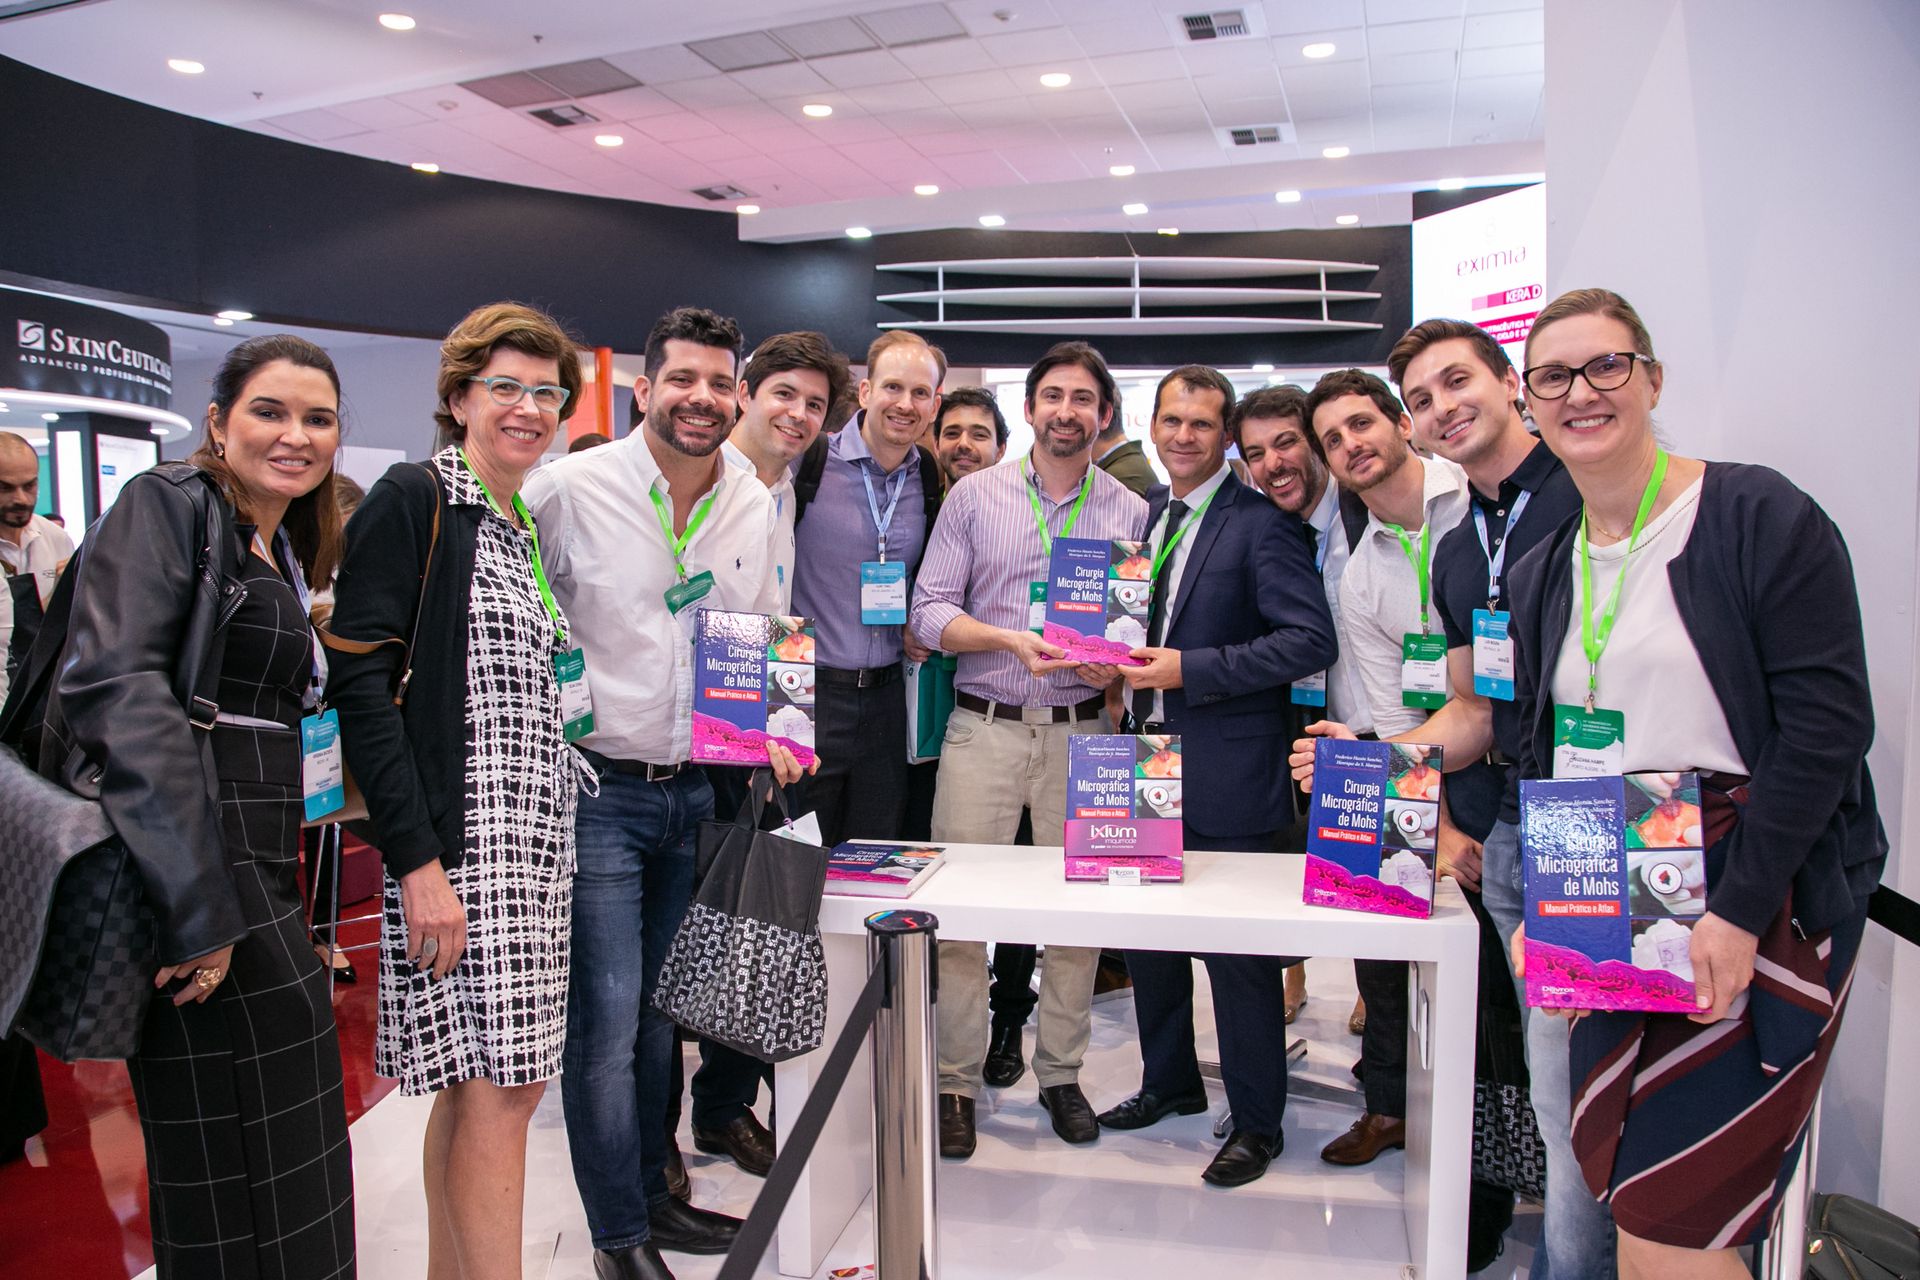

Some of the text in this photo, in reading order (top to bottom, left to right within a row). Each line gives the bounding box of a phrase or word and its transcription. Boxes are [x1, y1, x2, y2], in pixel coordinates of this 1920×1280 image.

[1457, 246, 1526, 276] eximia
[1505, 285, 1541, 303] KERA D
[20, 353, 88, 372] ADVANCED
[1075, 565, 1105, 580] Cirurgia
[1056, 577, 1104, 591] Micrográfica
[1070, 590, 1103, 602] de Mohs
[728, 644, 762, 662] Cirurgia
[706, 657, 762, 675] Micrográfica
[723, 673, 762, 689] de Mohs
[1097, 766, 1130, 781] Cirurgia
[1077, 779, 1130, 794] Micrográfica
[1344, 779, 1380, 798] Cirurgia
[1093, 793, 1130, 806] de Mohs
[1321, 793, 1379, 813] Micrográfica
[1338, 812, 1378, 829] de Mohs
[1089, 824, 1137, 839] ixium
[1323, 829, 1340, 839] Manual
[1537, 854, 1619, 877] Micrográfica
[1564, 876, 1620, 896] de Mohs
[1544, 903, 1569, 914] Manual
[1569, 903, 1592, 914] Prático
[1597, 903, 1616, 914] Atlas
